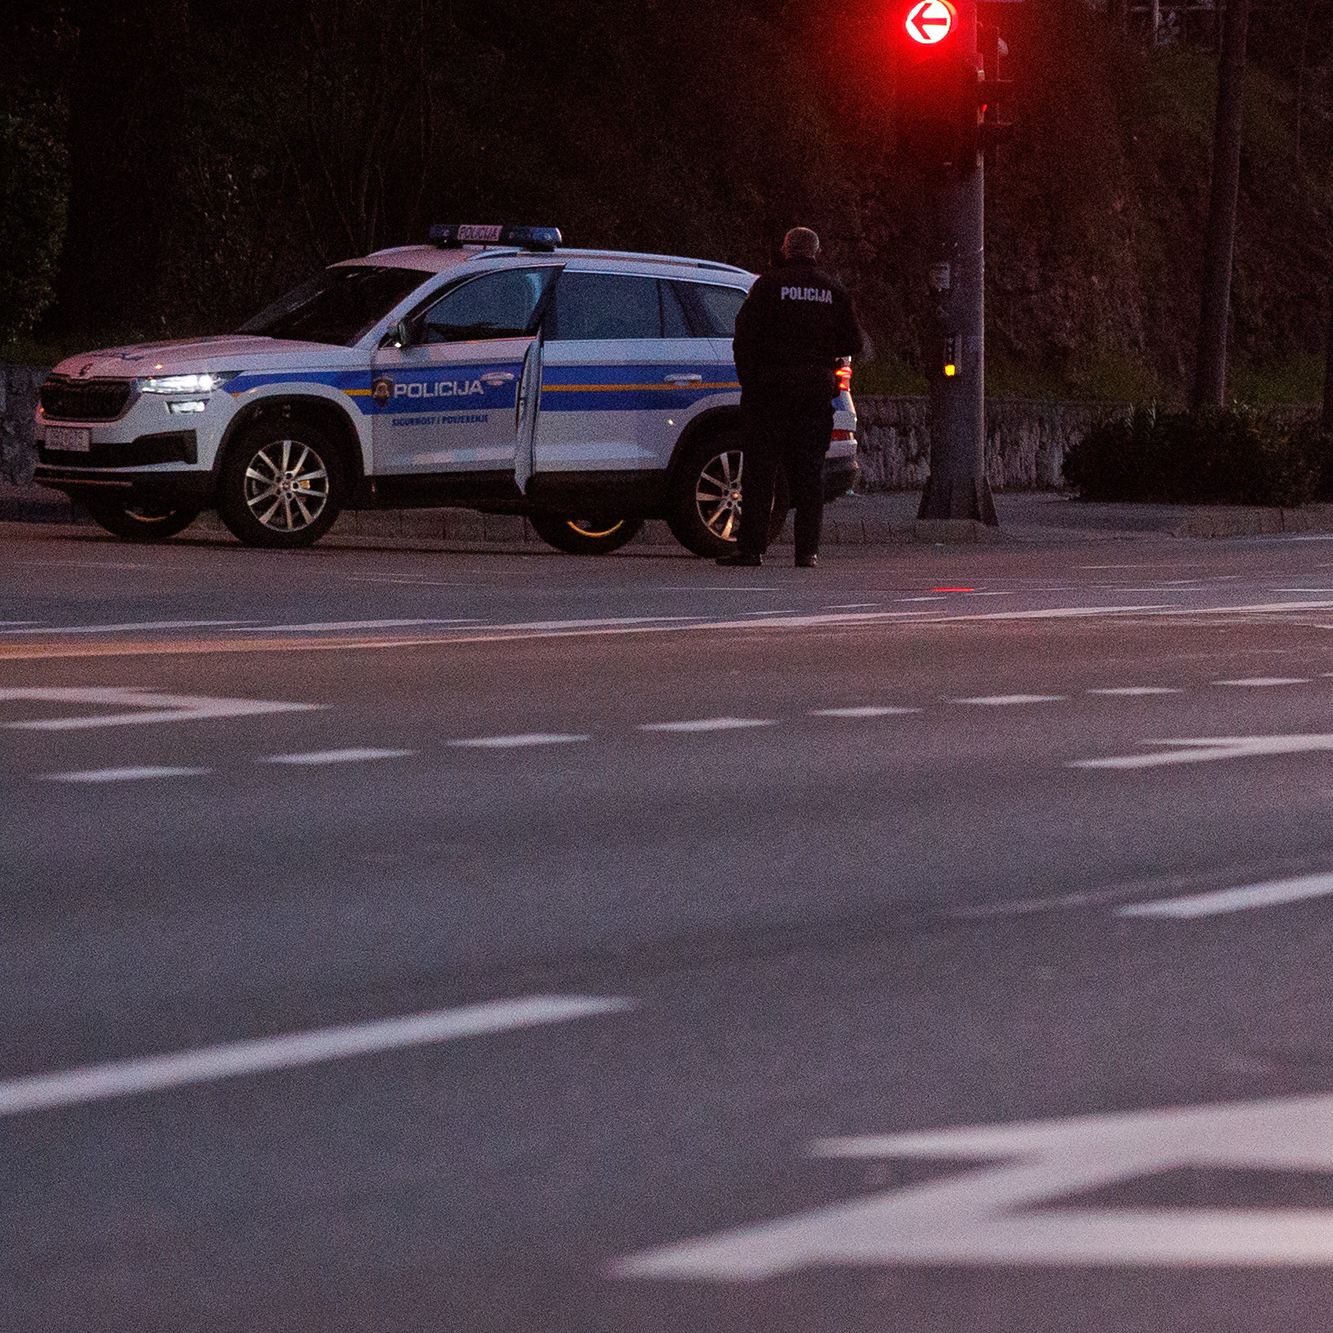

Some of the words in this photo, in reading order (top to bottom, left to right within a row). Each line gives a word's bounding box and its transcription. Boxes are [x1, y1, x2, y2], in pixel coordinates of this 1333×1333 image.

[459, 226, 499, 240] POLICIJA
[780, 286, 833, 304] POLICIJA
[393, 380, 485, 398] POLICIJA
